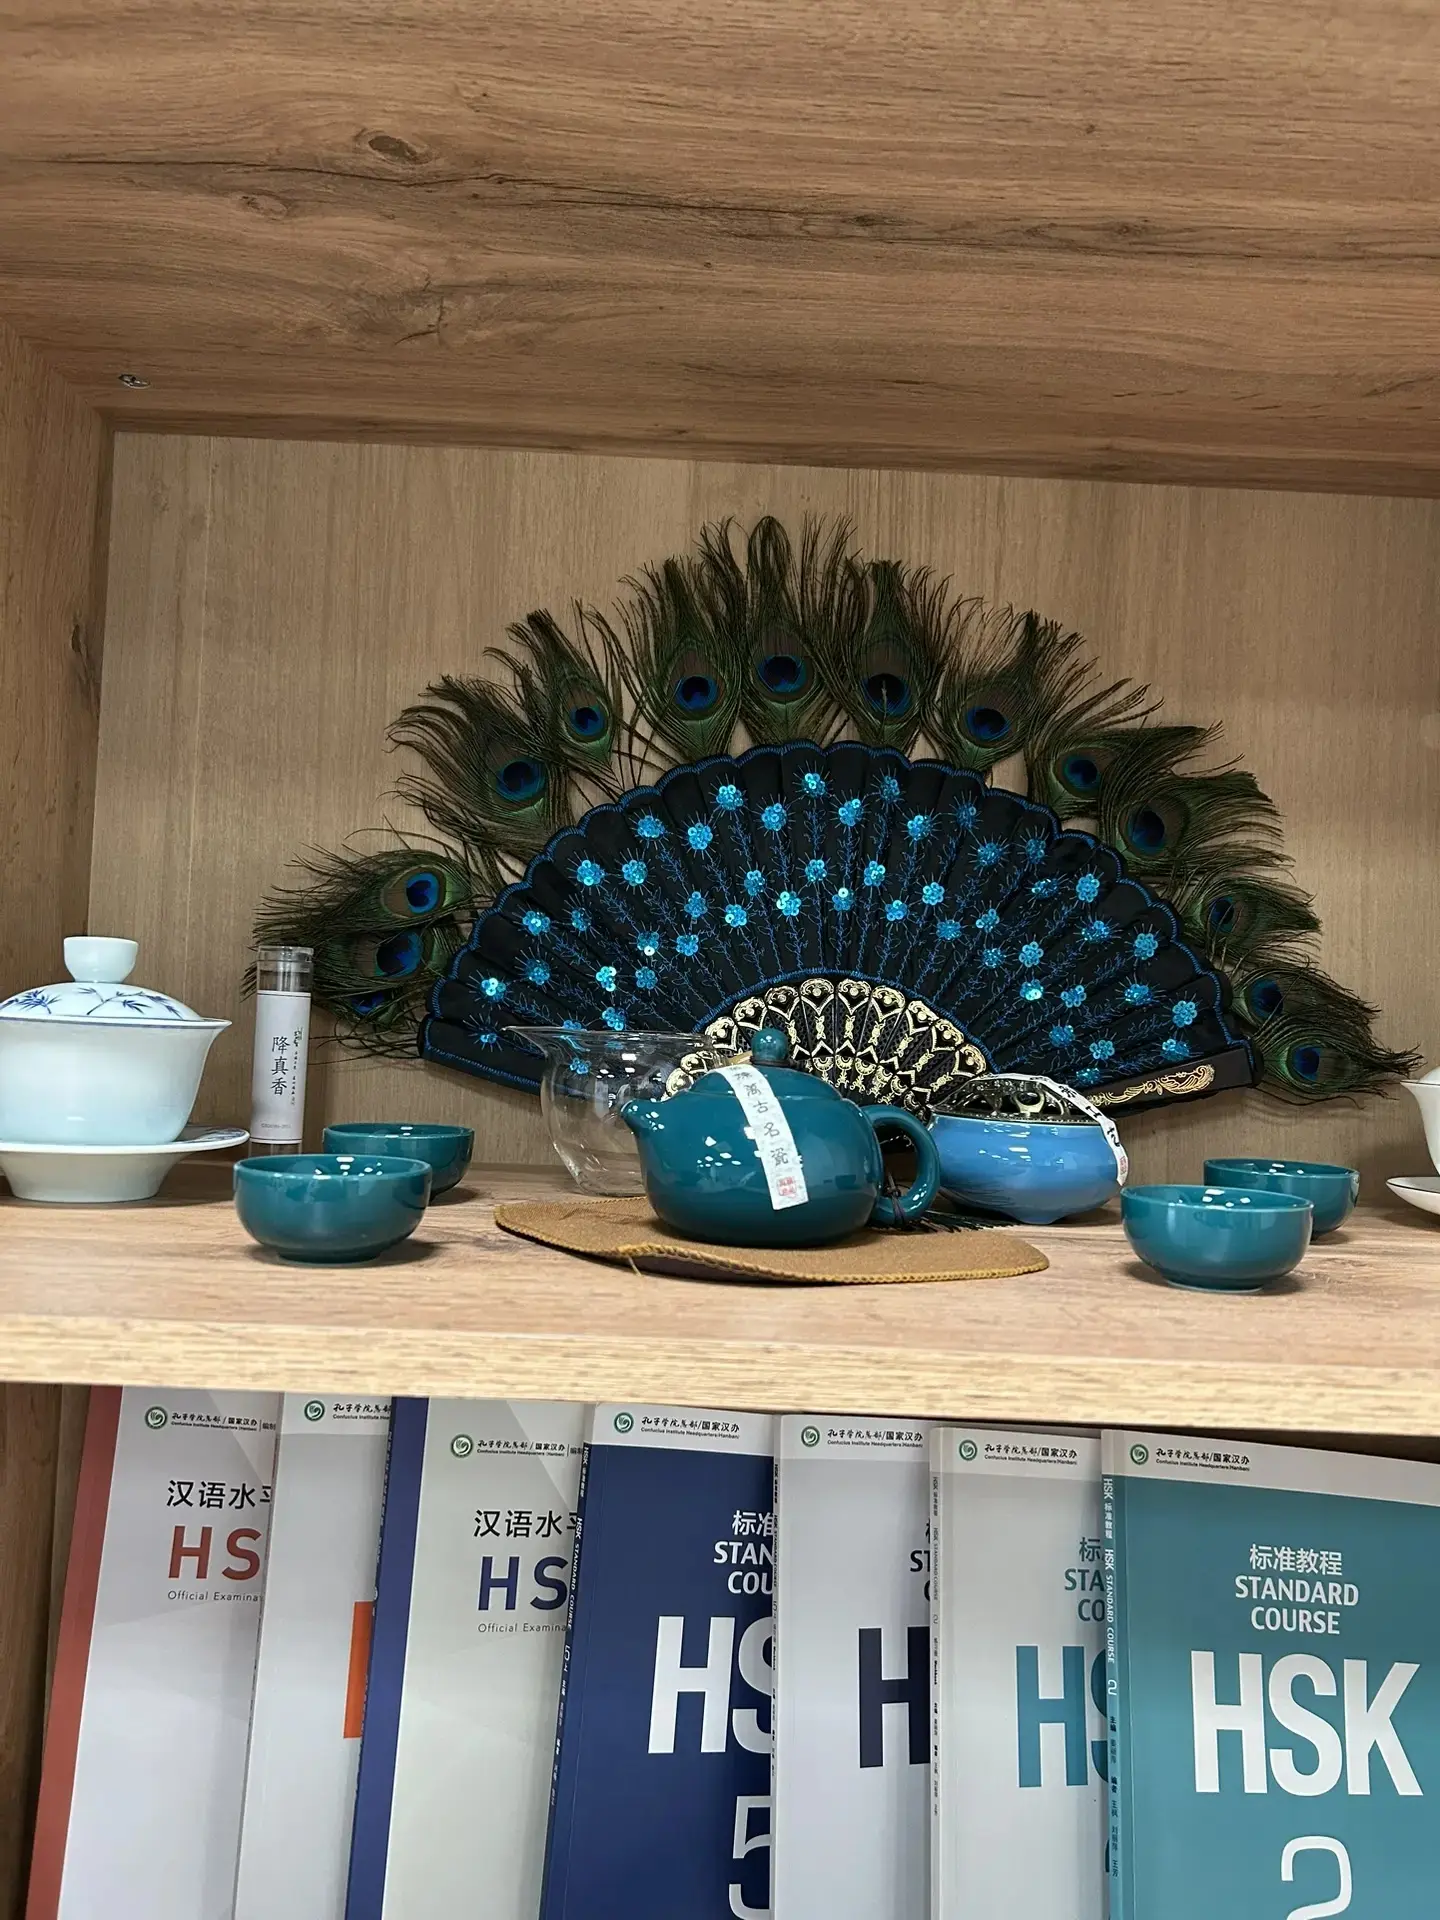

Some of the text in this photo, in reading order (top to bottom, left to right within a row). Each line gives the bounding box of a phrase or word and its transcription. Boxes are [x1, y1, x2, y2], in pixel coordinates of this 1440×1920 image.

[271, 1036, 290, 1095] 降真香
[1103, 1478, 1113, 1500] HSK
[575, 1517, 583, 1540] HSK
[168, 1526, 262, 1580] HS
[571, 1543, 580, 1591] STANDARD
[1079, 1537, 1105, 1561] 标
[1105, 1549, 1114, 1570] HSK
[1249, 1544, 1343, 1576] 标准教程
[168, 1590, 208, 1601] Official
[478, 1556, 568, 1611] HS
[1106, 1575, 1114, 1623] STANDARD
[1235, 1575, 1359, 1606] STANDARD
[478, 1623, 518, 1633] Official
[567, 1594, 575, 1631] COURSE
[1251, 1606, 1340, 1635] COURSE
[1107, 1627, 1115, 1664] COURSE
[1016, 1645, 1108, 1787] H
[1191, 1651, 1423, 1796] HSK
[1281, 1835, 1352, 1920] 2
